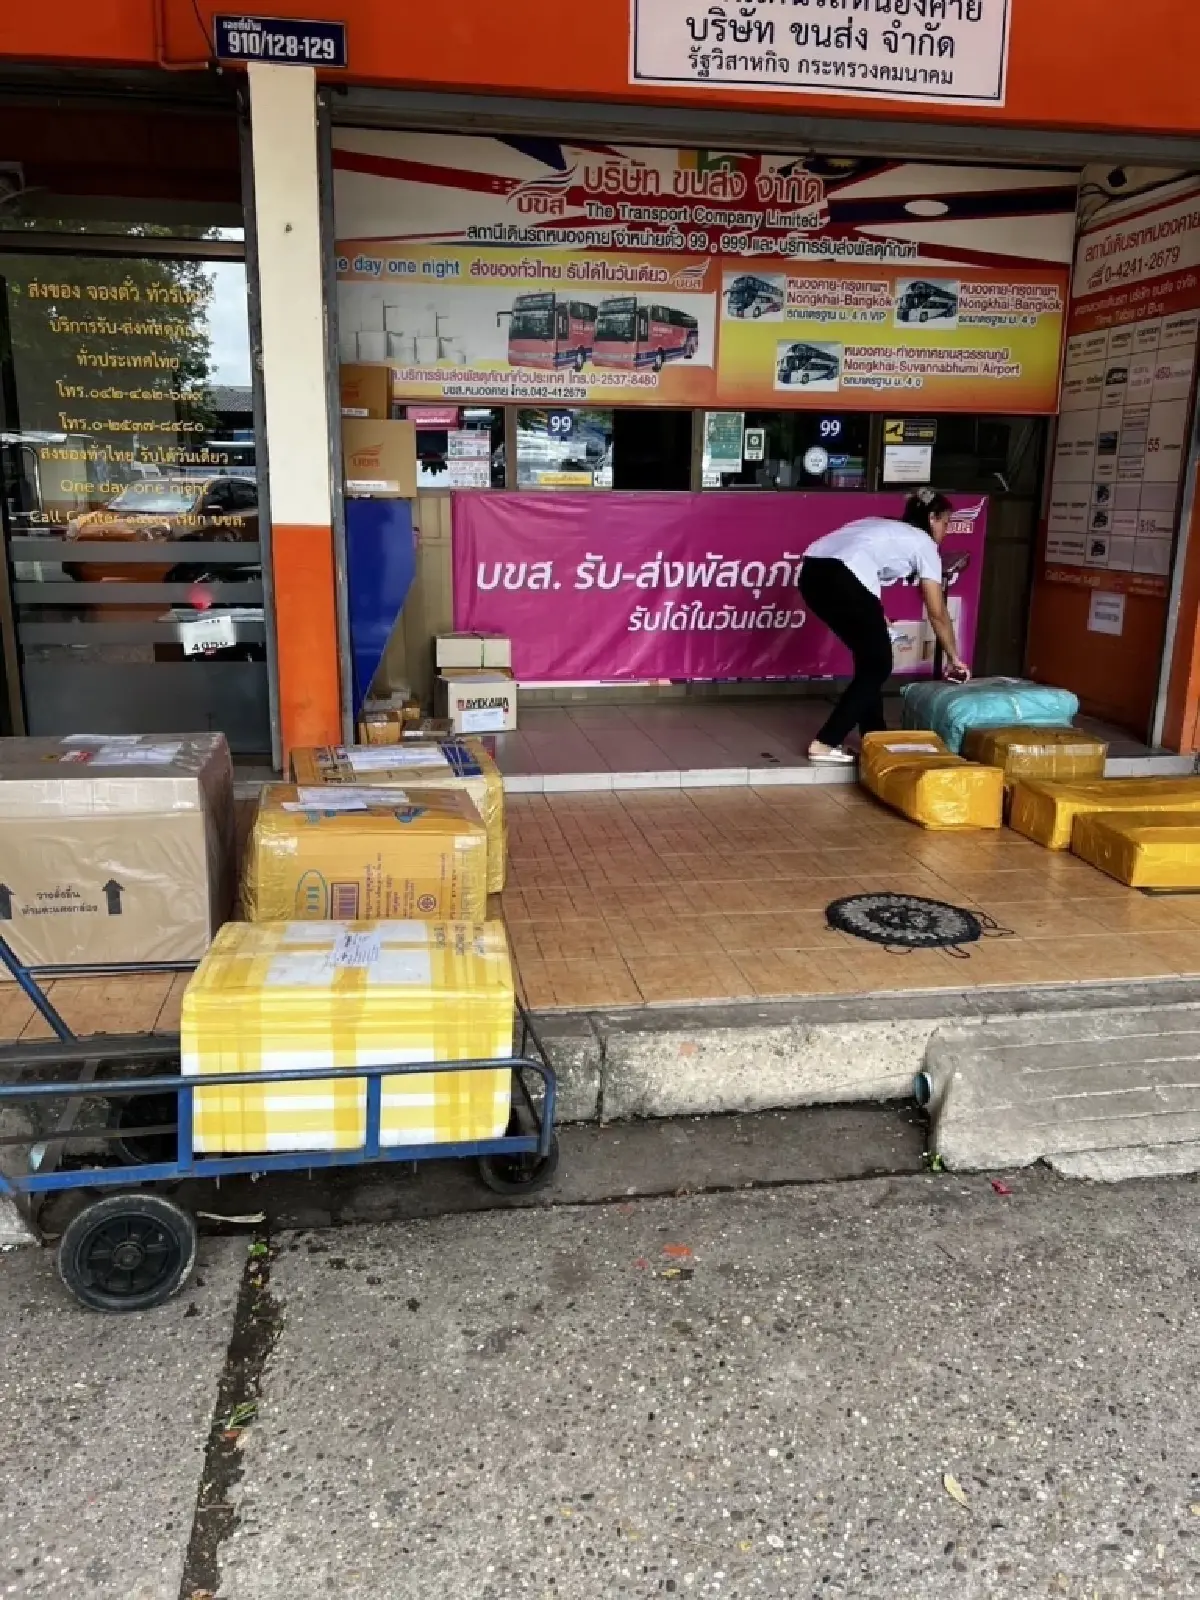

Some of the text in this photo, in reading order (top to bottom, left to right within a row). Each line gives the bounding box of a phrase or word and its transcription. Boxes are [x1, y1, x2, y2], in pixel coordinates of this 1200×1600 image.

[686, 7, 775, 45] บริษัท
[790, 17, 868, 50] ขนส่ง
[882, 20, 955, 58] จำกัด
[229, 31, 335, 59] 910/128-129
[688, 47, 953, 85] รัฐวิสาหกิจ กระทรวงคมนาคม
[583, 160, 826, 204] บริษัท ขนส่ง จำกัด
[586, 203, 613, 219] The
[618, 204, 690, 226] Transport
[694, 206, 762, 230] Company
[690, 233, 707, 248] 99
[722, 235, 747, 250] 999
[354, 256, 383, 276] day
[388, 259, 417, 274] one
[422, 258, 460, 278] night
[470, 257, 668, 283] ส่งของทั่วไทย รับได้ในวันเดียว
[1104, 245, 1181, 283] 0-4241-2679
[28, 279, 81, 299] ส่งของ
[787, 291, 892, 309] Nongkhai-Bangkok
[959, 297, 1062, 312] Nongkhai-Bangkok
[76, 346, 181, 370] ทั่วประเทศไทย
[983, 363, 1020, 377] Airport
[551, 415, 572, 431] 99
[820, 419, 841, 436] 99
[61, 479, 209, 498] One day one night
[29, 509, 62, 524] Call
[476, 560, 561, 591] บขส.
[627, 601, 806, 632] รับได้ในวันเดียว
